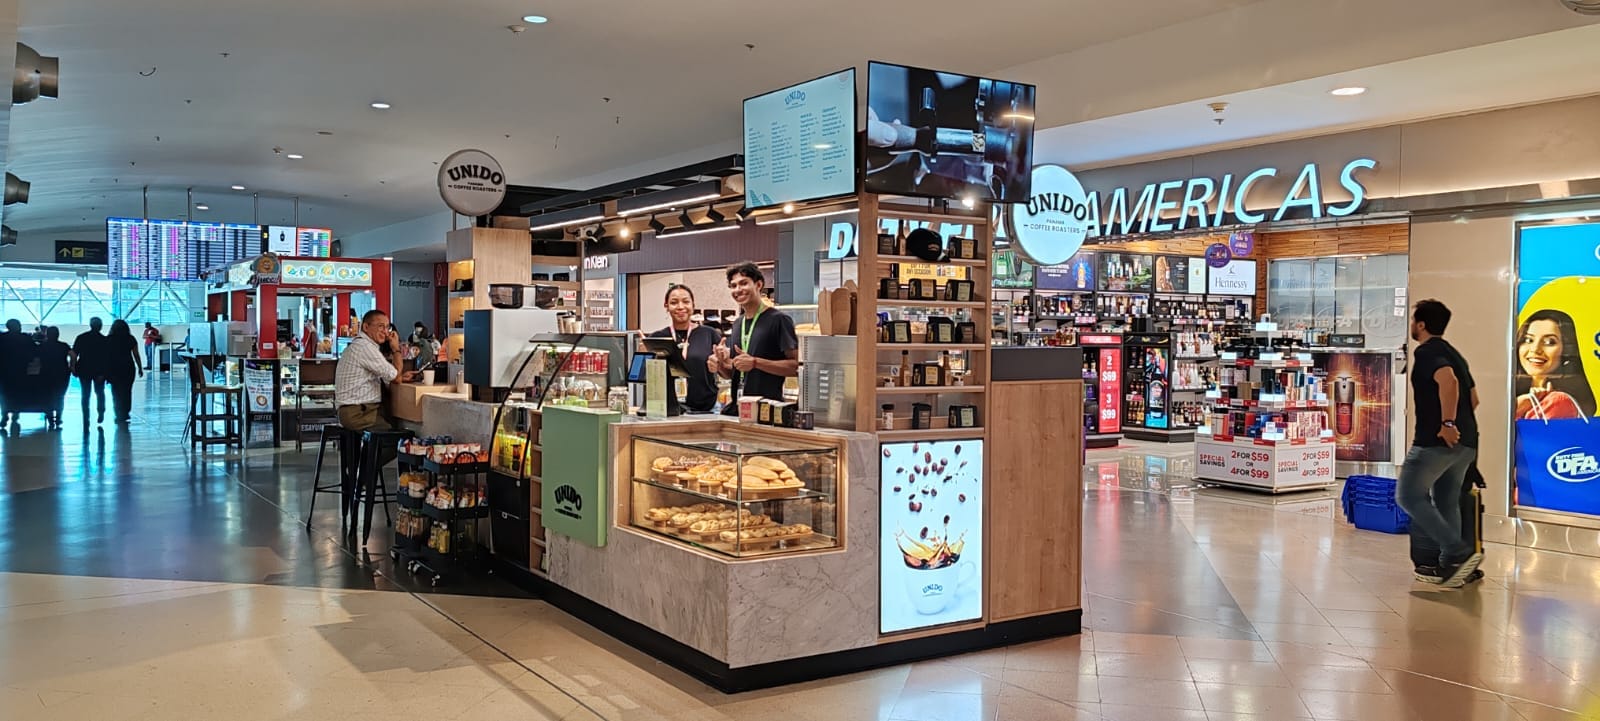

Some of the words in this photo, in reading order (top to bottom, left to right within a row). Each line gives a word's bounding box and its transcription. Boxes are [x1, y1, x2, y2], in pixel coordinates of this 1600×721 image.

[447, 164, 503, 185] UNIDO
[1026, 192, 1087, 221] UNIDO
[1052, 225, 1080, 234] ROASTERS
[1215, 277, 1248, 290] Hennessy
[1106, 355, 1113, 365] 2
[1106, 394, 1112, 404] 3
[1199, 453, 1225, 462] SPECIAL
[1555, 455, 1599, 476] DFA
[554, 484, 582, 511] UNIDO
[922, 584, 943, 594] UNIDO
